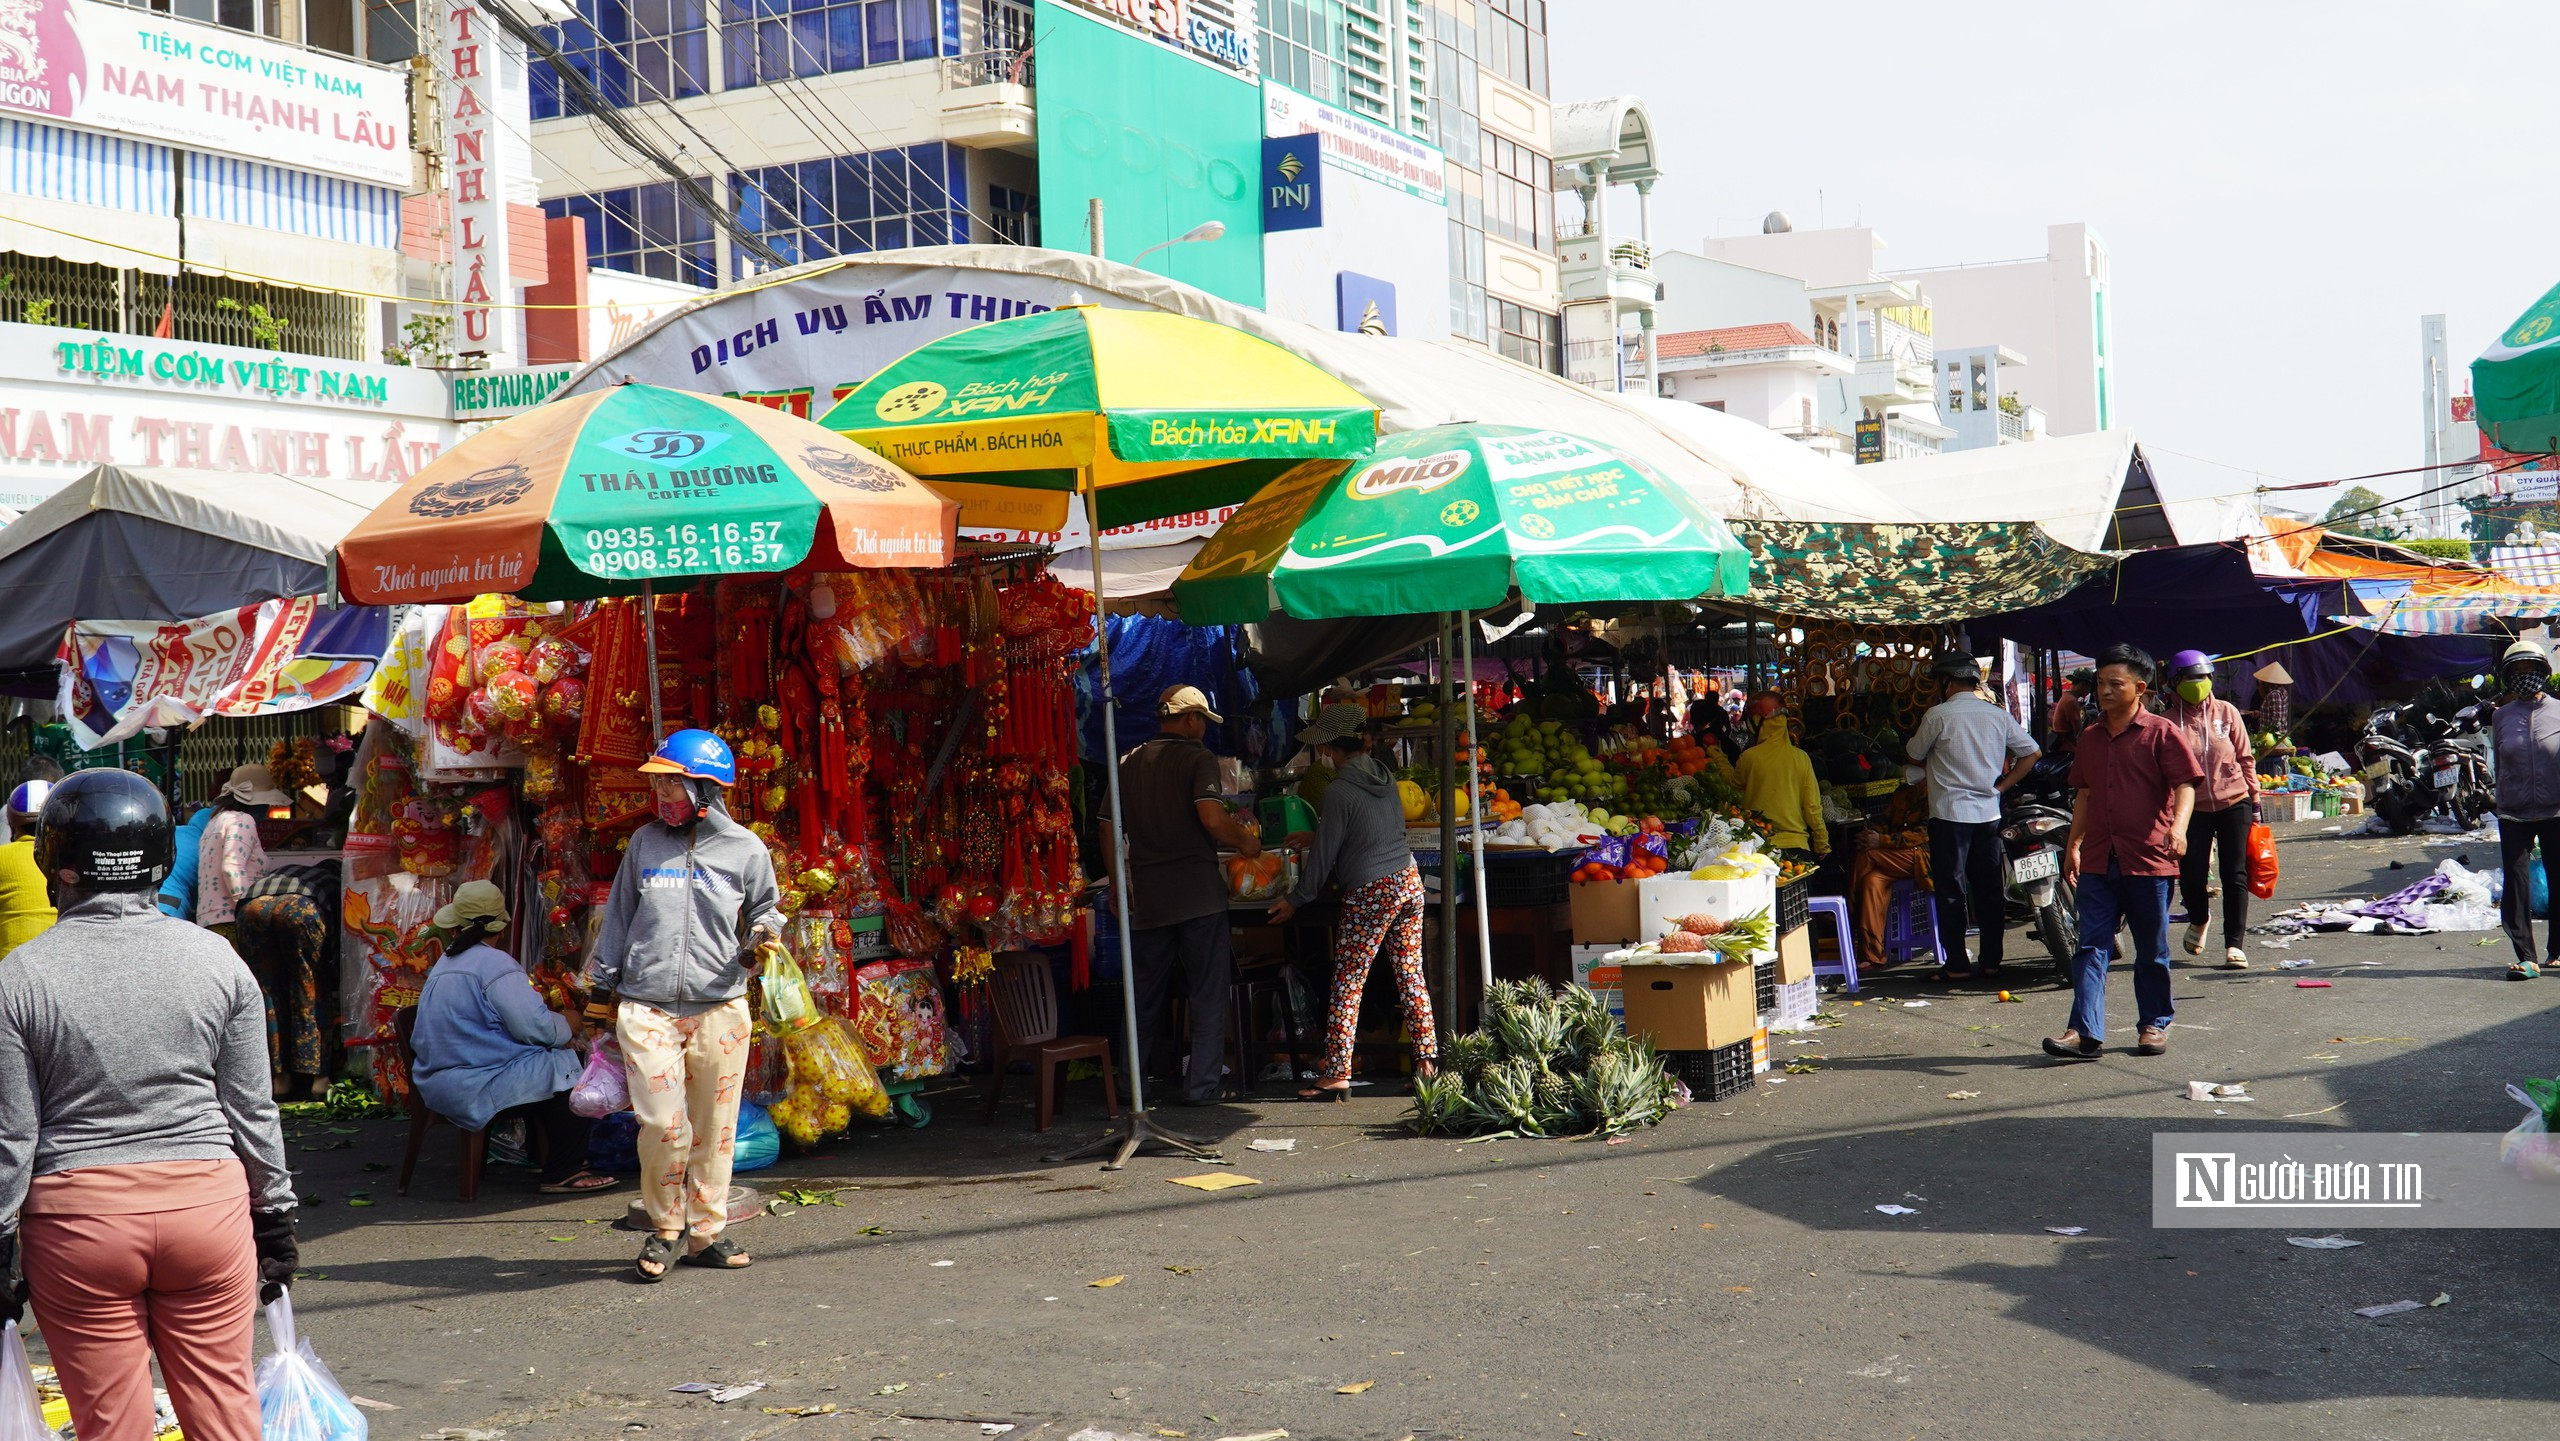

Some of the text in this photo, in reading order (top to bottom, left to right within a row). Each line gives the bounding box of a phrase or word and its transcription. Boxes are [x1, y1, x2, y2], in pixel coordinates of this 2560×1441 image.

[1, 66, 25, 83] BIA
[138, 31, 363, 99] TIỆM CƠM VIỆT NAM
[103, 63, 396, 151] NAM THẠNH LẦU
[1271, 183, 1311, 211] PNJ
[690, 318, 779, 375] DỊCH
[795, 304, 848, 336] VỤ
[864, 288, 932, 325] ẨM
[57, 337, 389, 402] TIỆM CƠM VIỆT NAM
[956, 371, 1070, 397] Bách hóa
[934, 386, 1057, 418] XANH
[893, 441, 930, 459] THỰC
[935, 431, 977, 454] PHẨM
[987, 432, 1027, 451] BÁCH
[1031, 429, 1063, 448] HÓA
[1151, 418, 1336, 446] Bách hóa XANH
[579, 464, 778, 492] THÁI DƯƠNG
[1364, 460, 1459, 488] MILO
[1509, 483, 1547, 497] CHO
[1548, 474, 1585, 492] TIẾT
[647, 488, 720, 500] COFFEE
[586, 521, 782, 551] 0935.16.16.57
[589, 544, 784, 572] 0908.52.16.57
[420, 555, 469, 592] nguồn
[499, 553, 523, 584] tuệ
[2018, 864, 2055, 882] 706.72
[2020, 854, 2049, 870] 86-C1
